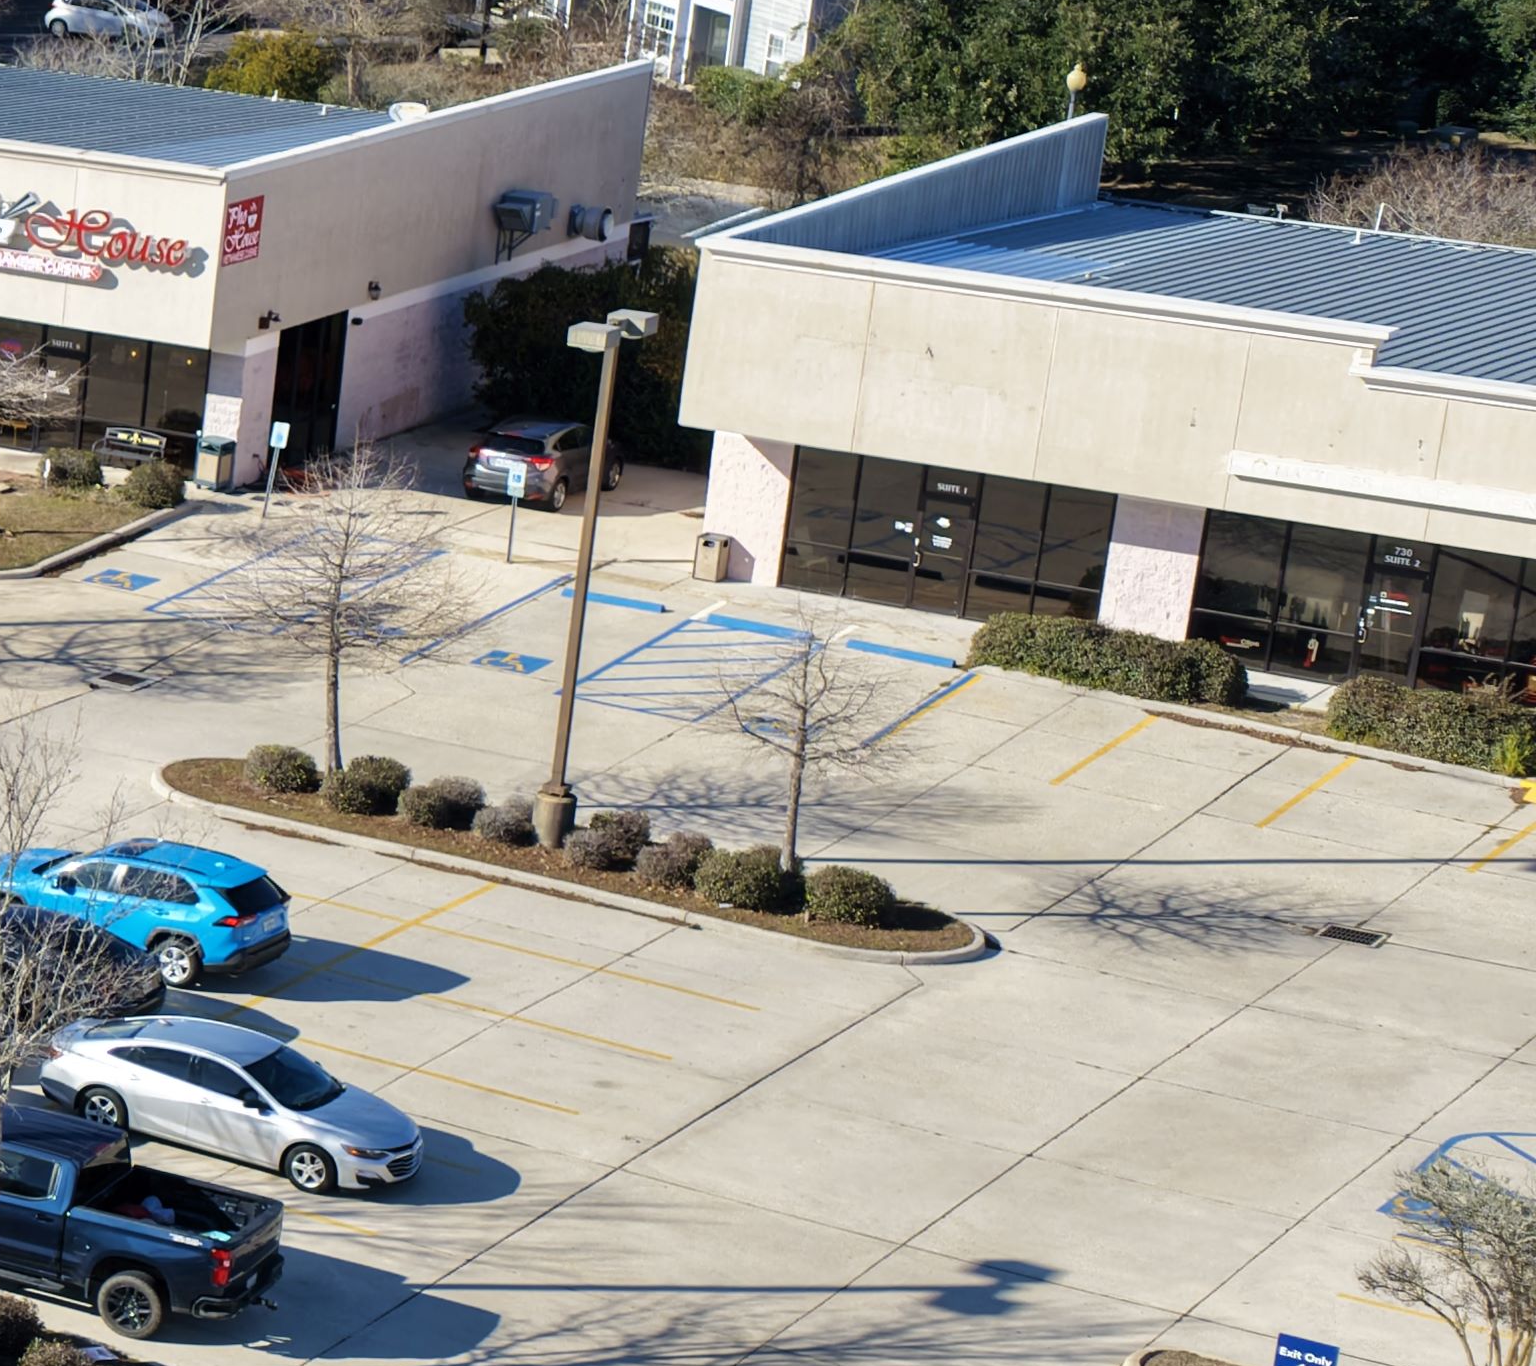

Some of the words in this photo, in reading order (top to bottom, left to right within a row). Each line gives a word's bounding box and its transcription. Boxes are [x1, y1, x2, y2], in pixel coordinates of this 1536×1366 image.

[227, 204, 248, 229] Pho
[25, 208, 190, 266] House
[936, 482, 960, 494] SUITE
[1394, 546, 1413, 557] 730
[1383, 555, 1411, 566] SUITE
[1413, 559, 1421, 568] 2
[1278, 1346, 1302, 1361] Exit
